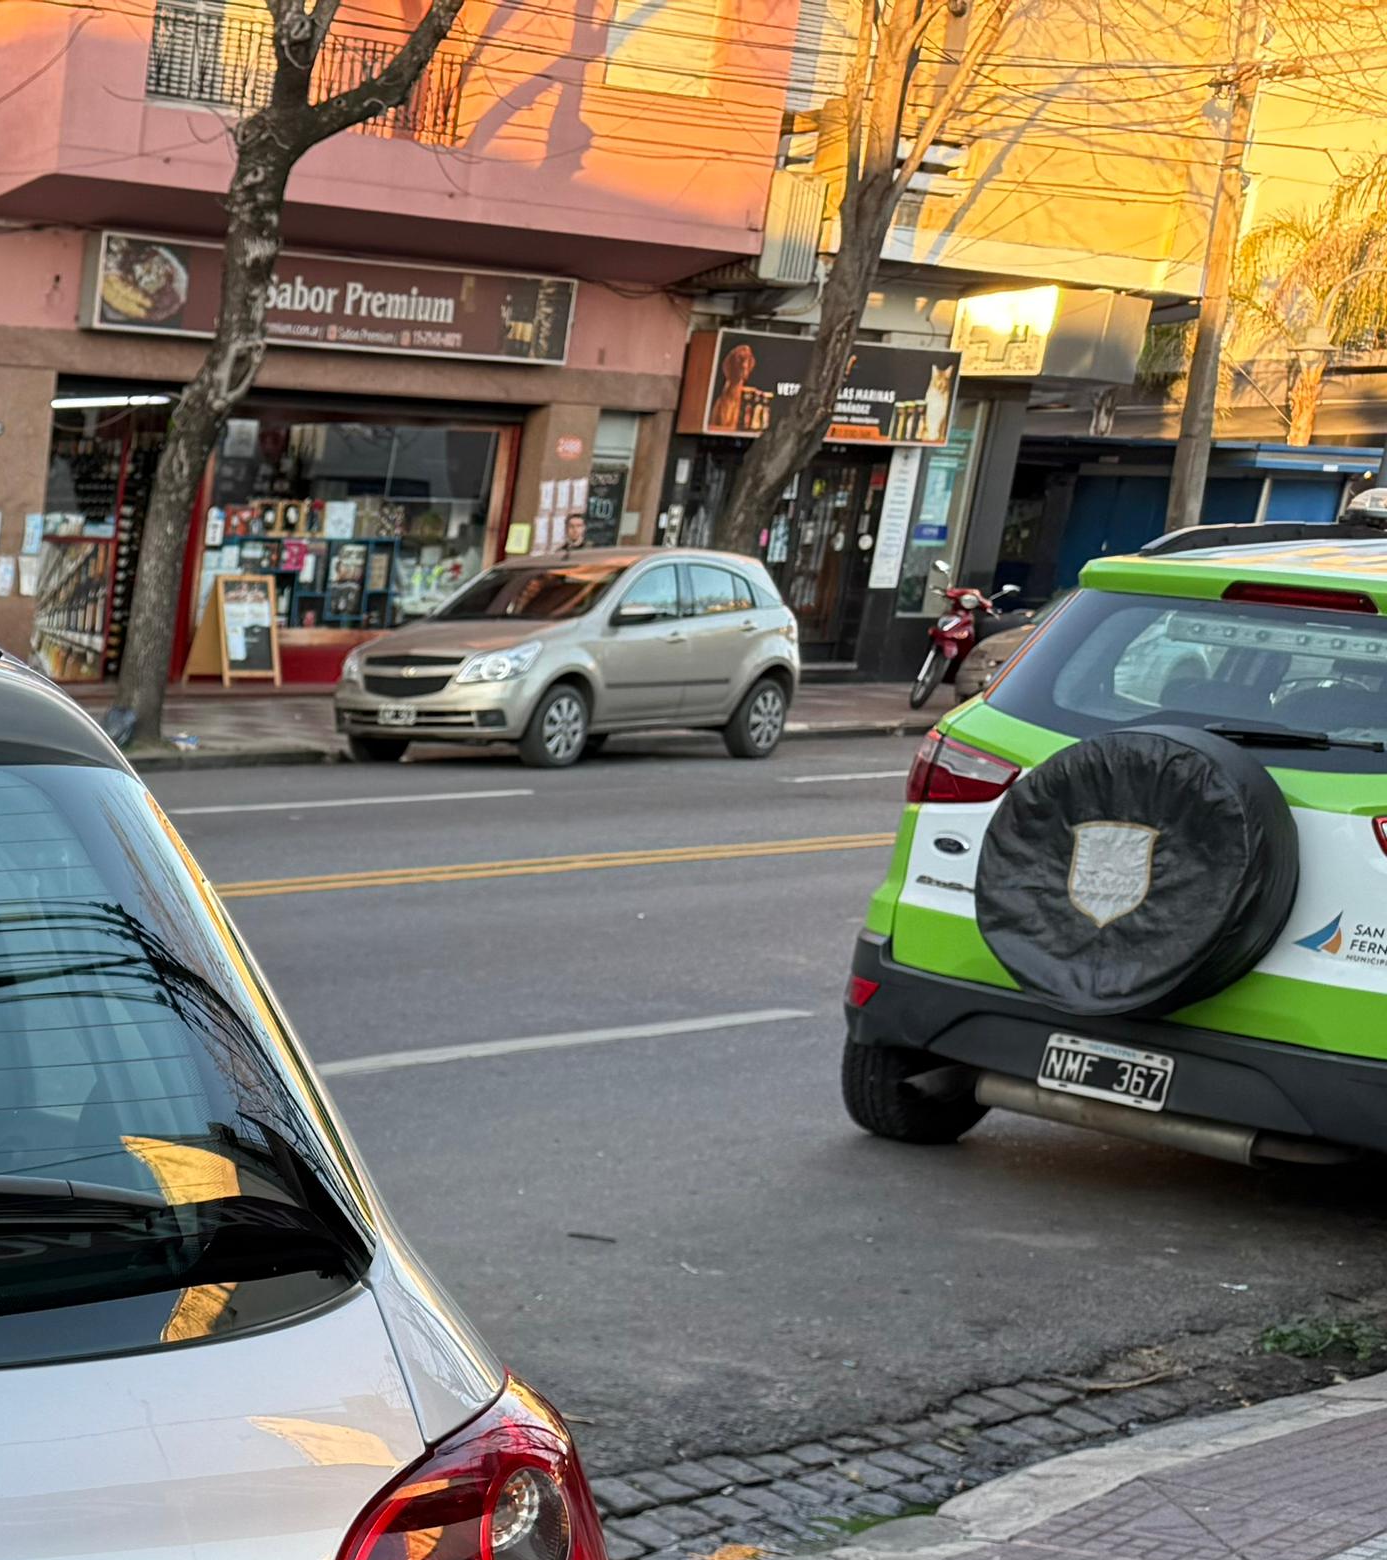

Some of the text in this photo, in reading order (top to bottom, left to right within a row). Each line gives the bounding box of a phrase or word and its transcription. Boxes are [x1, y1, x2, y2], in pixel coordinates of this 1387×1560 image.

[265, 274, 455, 324] Sabor Premium
[1354, 924, 1385, 938] SAN
[1045, 1048, 1165, 1099] NMF 367
